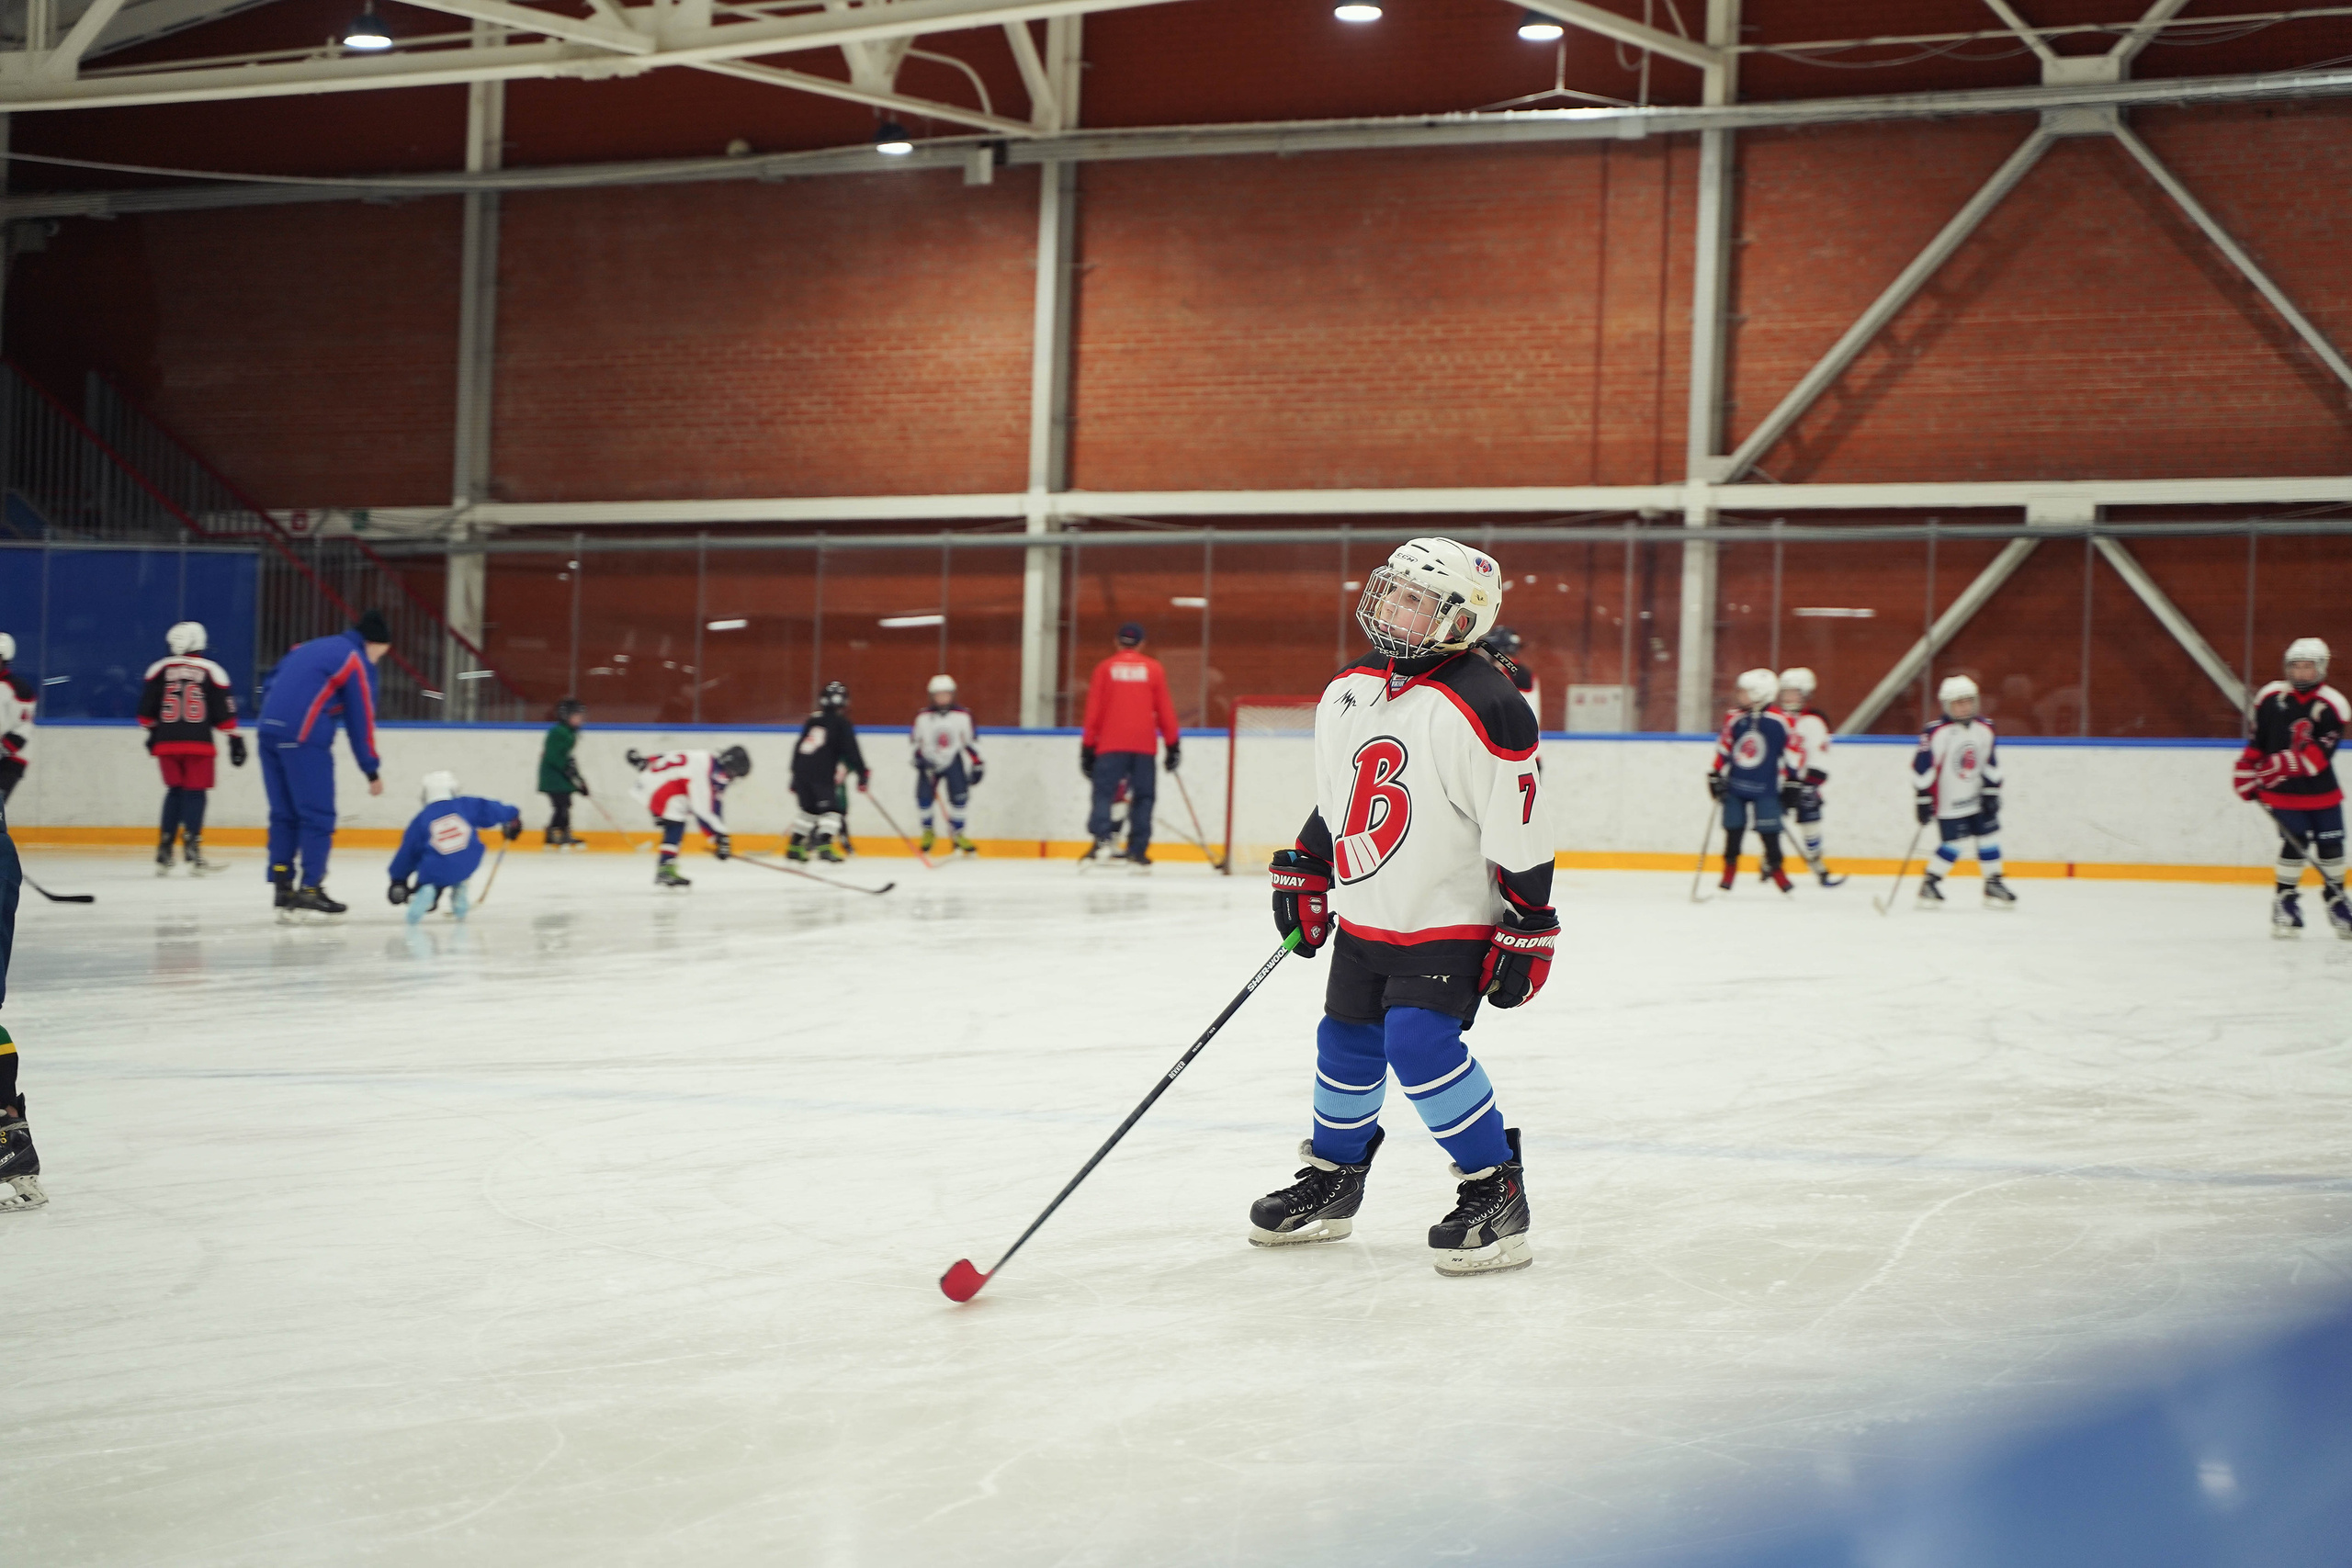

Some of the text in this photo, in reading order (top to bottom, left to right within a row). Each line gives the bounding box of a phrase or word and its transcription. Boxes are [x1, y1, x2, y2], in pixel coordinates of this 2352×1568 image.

[1396, 552, 1415, 562] CCM
[1493, 651, 1518, 672] ITEC
[161, 682, 206, 724] 56
[1518, 773, 1536, 825] 7
[1168, 1061, 1186, 1079] REKKER
